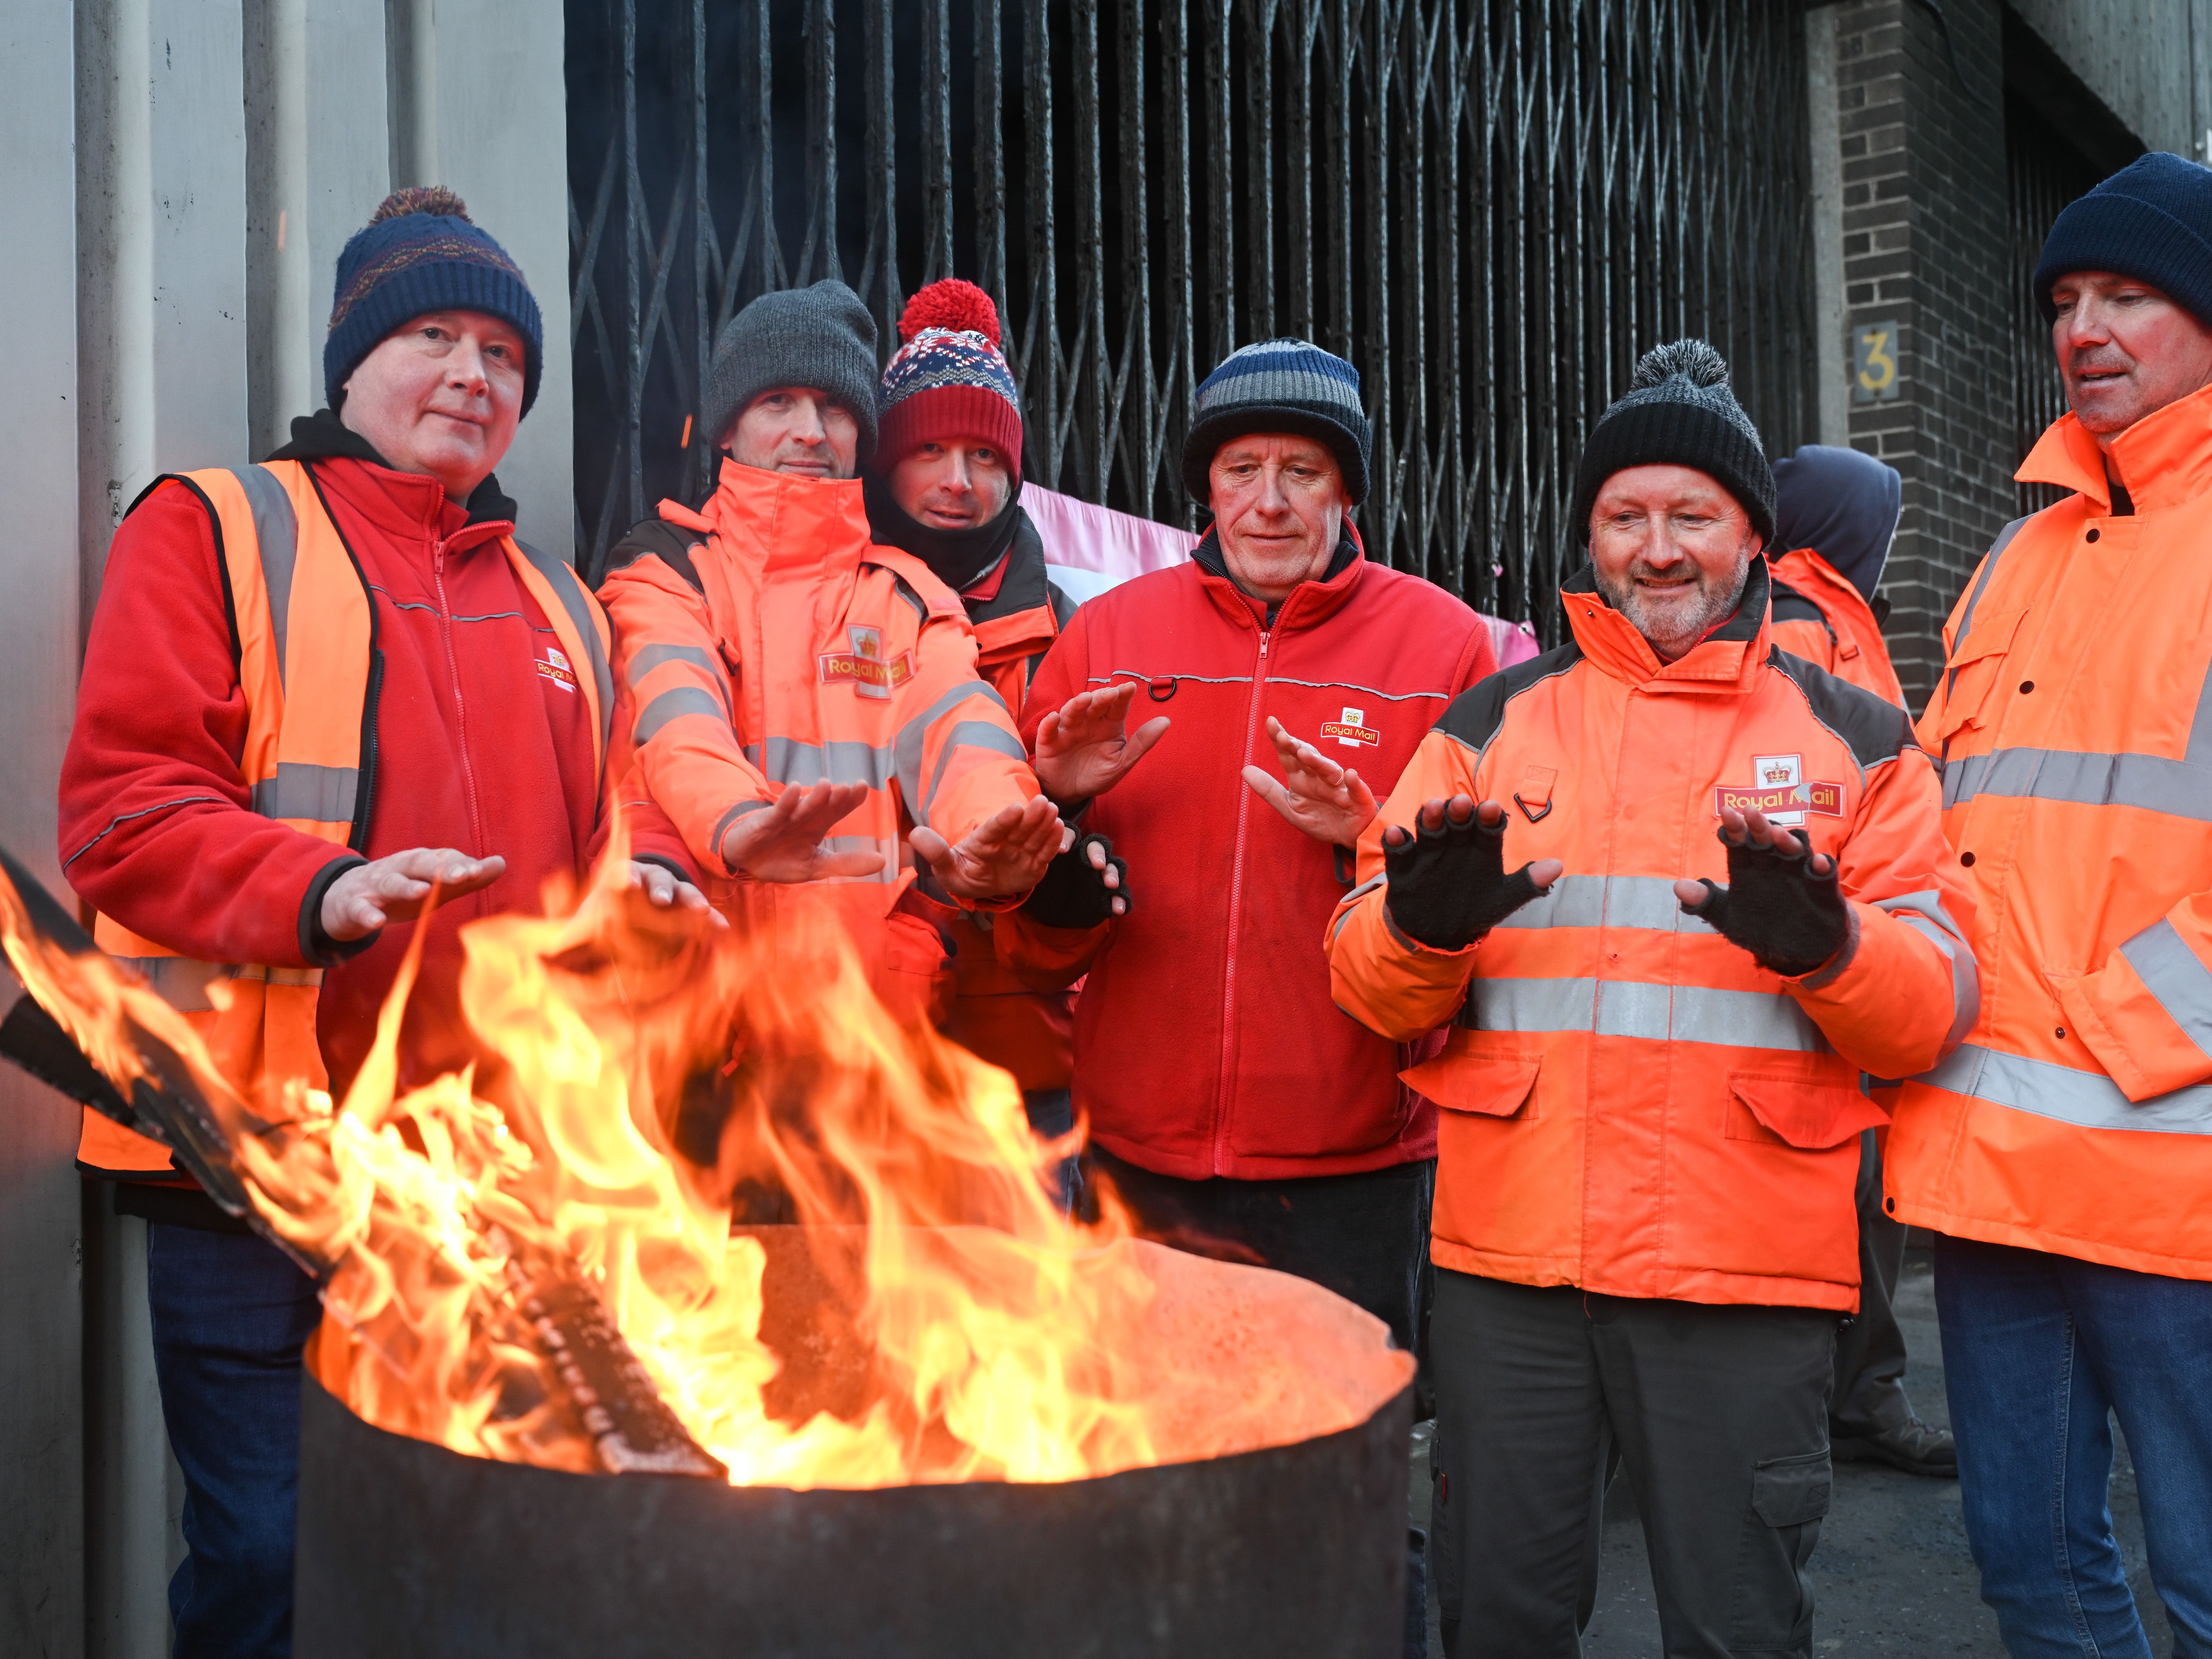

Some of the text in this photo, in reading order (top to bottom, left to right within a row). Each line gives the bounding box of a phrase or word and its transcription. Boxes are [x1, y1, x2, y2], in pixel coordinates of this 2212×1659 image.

[1859, 332, 1895, 390] 3
[538, 663, 564, 679] Royal
[829, 659, 906, 680] Royal Mail
[1325, 725, 1375, 741] Royal Mail
[1724, 791, 1783, 810] Royal
